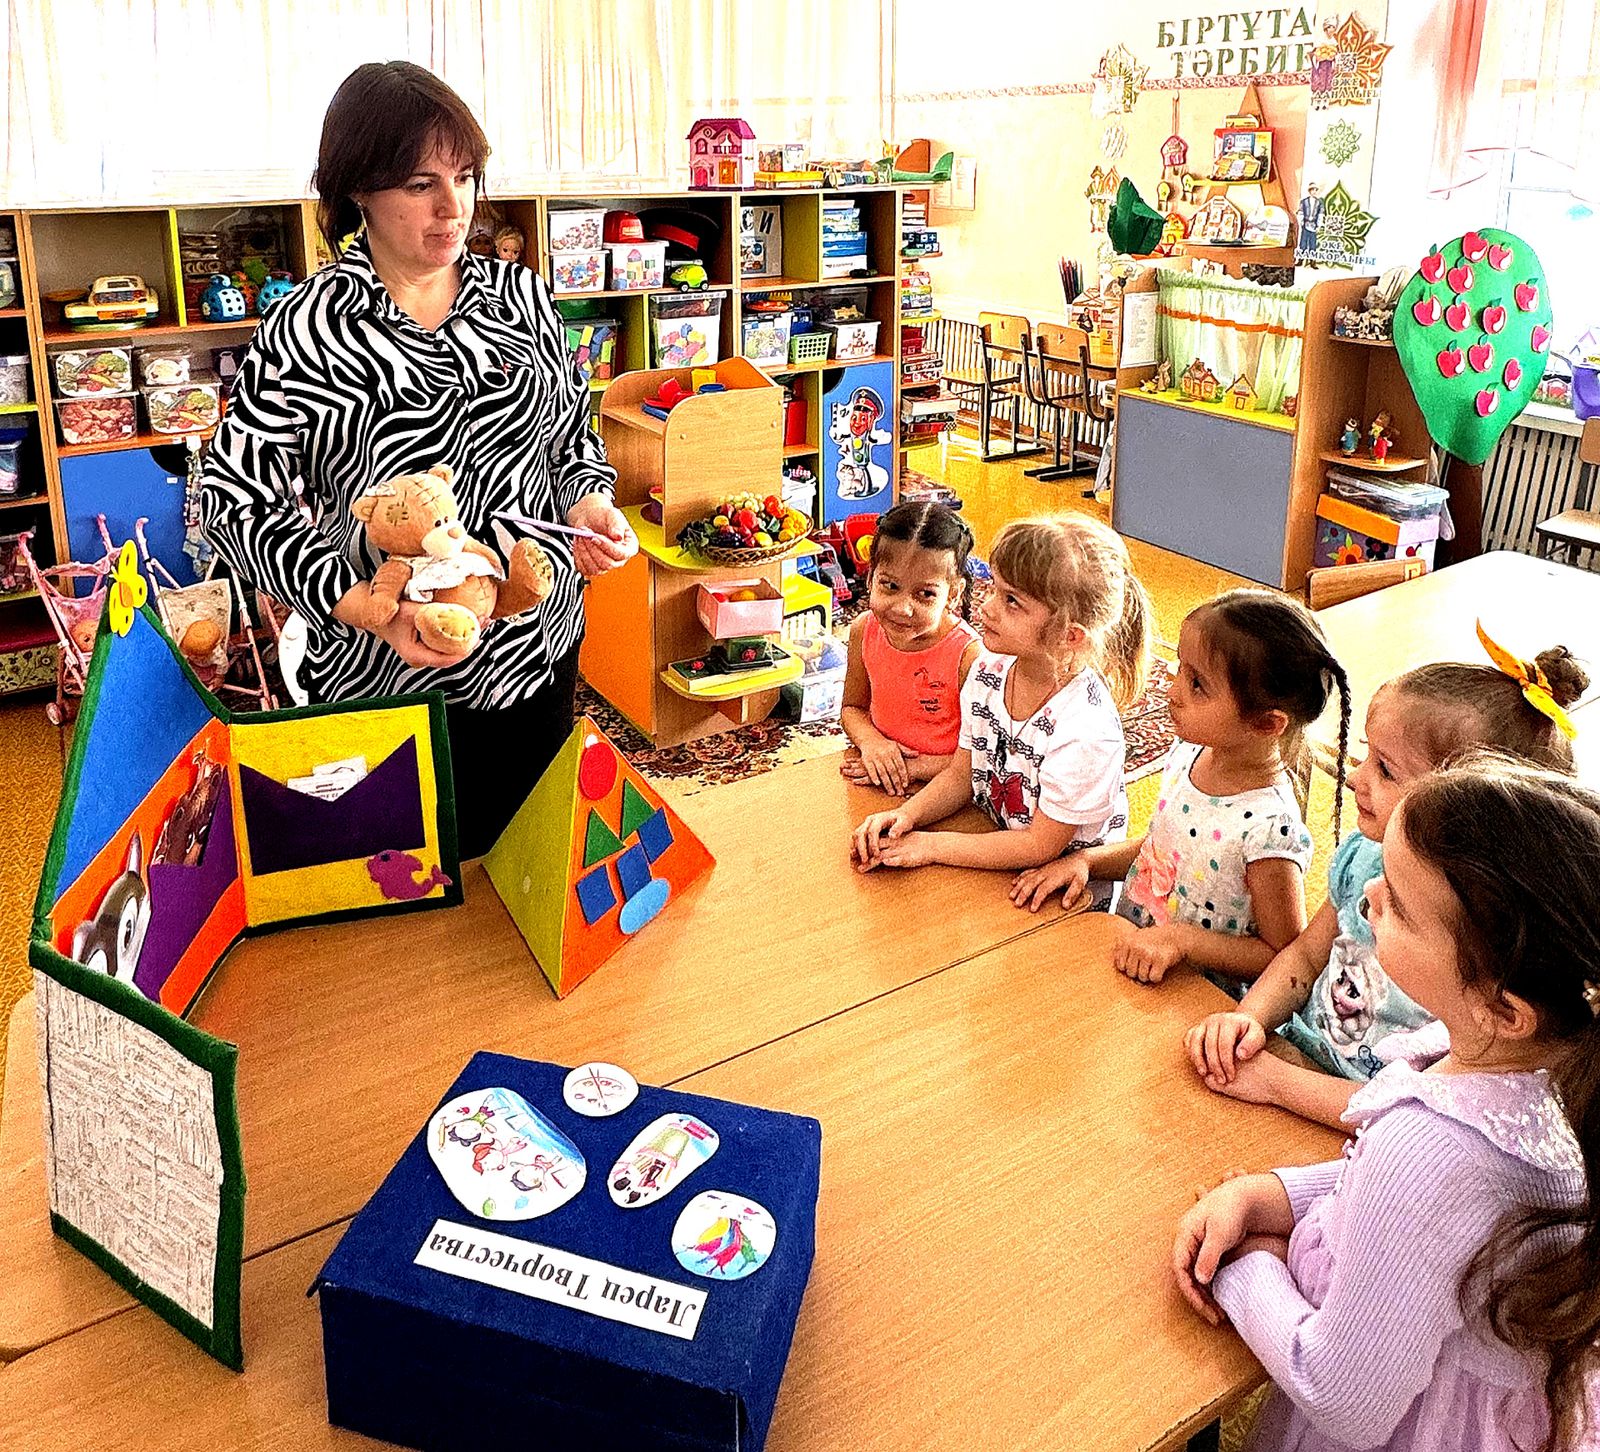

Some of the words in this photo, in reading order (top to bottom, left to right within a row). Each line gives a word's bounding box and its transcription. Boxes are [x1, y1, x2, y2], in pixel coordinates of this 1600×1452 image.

[1156, 7, 1317, 48] БІРТҰТА
[429, 1232, 591, 1300] Творчества
[601, 1275, 697, 1327] Ларец
